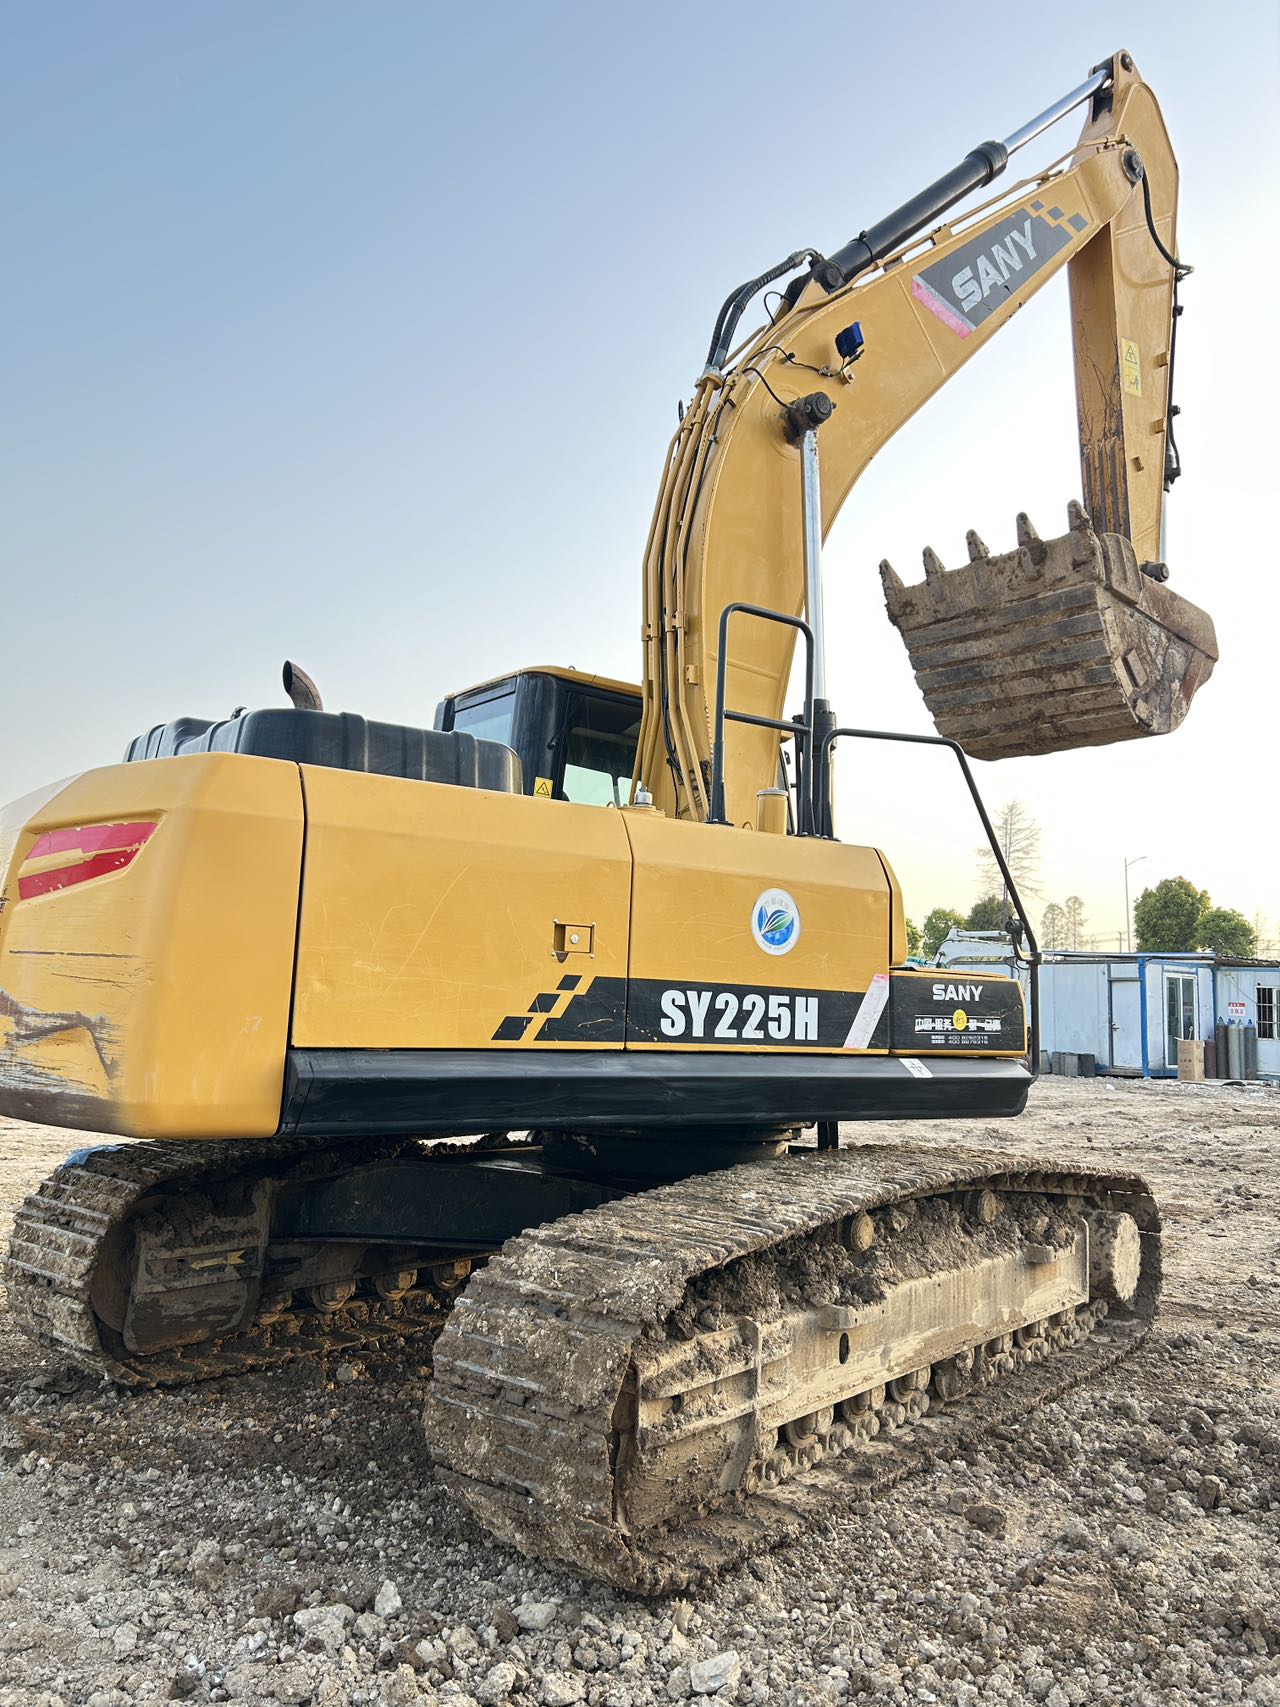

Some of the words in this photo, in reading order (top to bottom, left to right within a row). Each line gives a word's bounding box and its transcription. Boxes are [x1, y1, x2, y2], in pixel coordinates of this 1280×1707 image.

[951, 218, 1037, 313] SANY
[660, 989, 819, 1041] SY225H
[932, 983, 983, 1002] SANY
